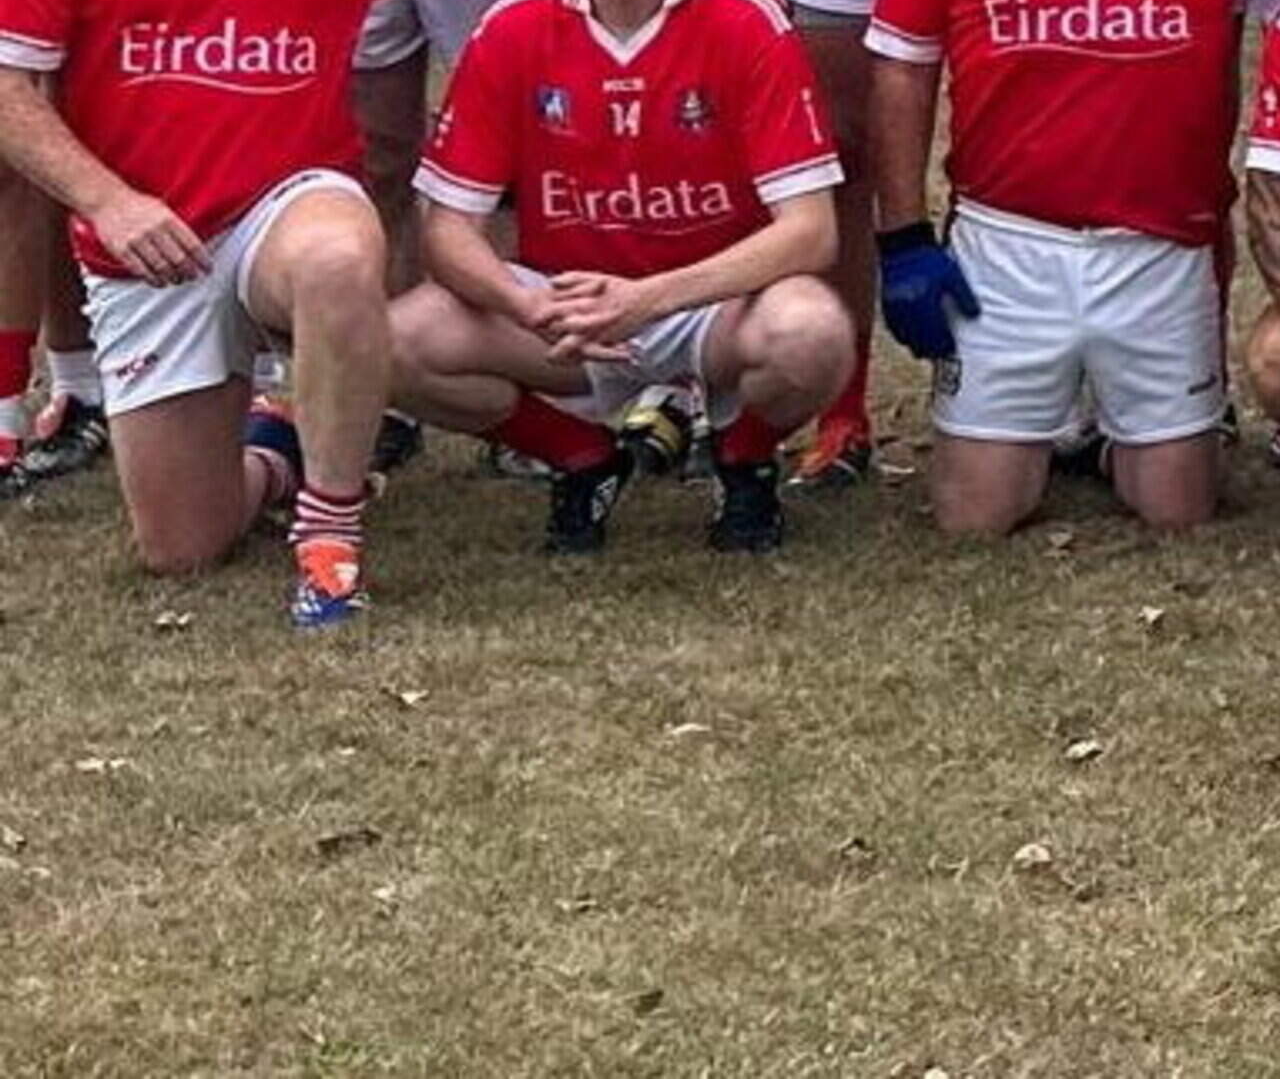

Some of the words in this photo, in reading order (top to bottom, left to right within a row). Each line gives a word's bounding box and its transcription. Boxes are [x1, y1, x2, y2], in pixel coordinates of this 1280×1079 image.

[120, 18, 318, 75] Eirdata
[610, 100, 642, 137] 14
[541, 170, 732, 220] Eirdata
